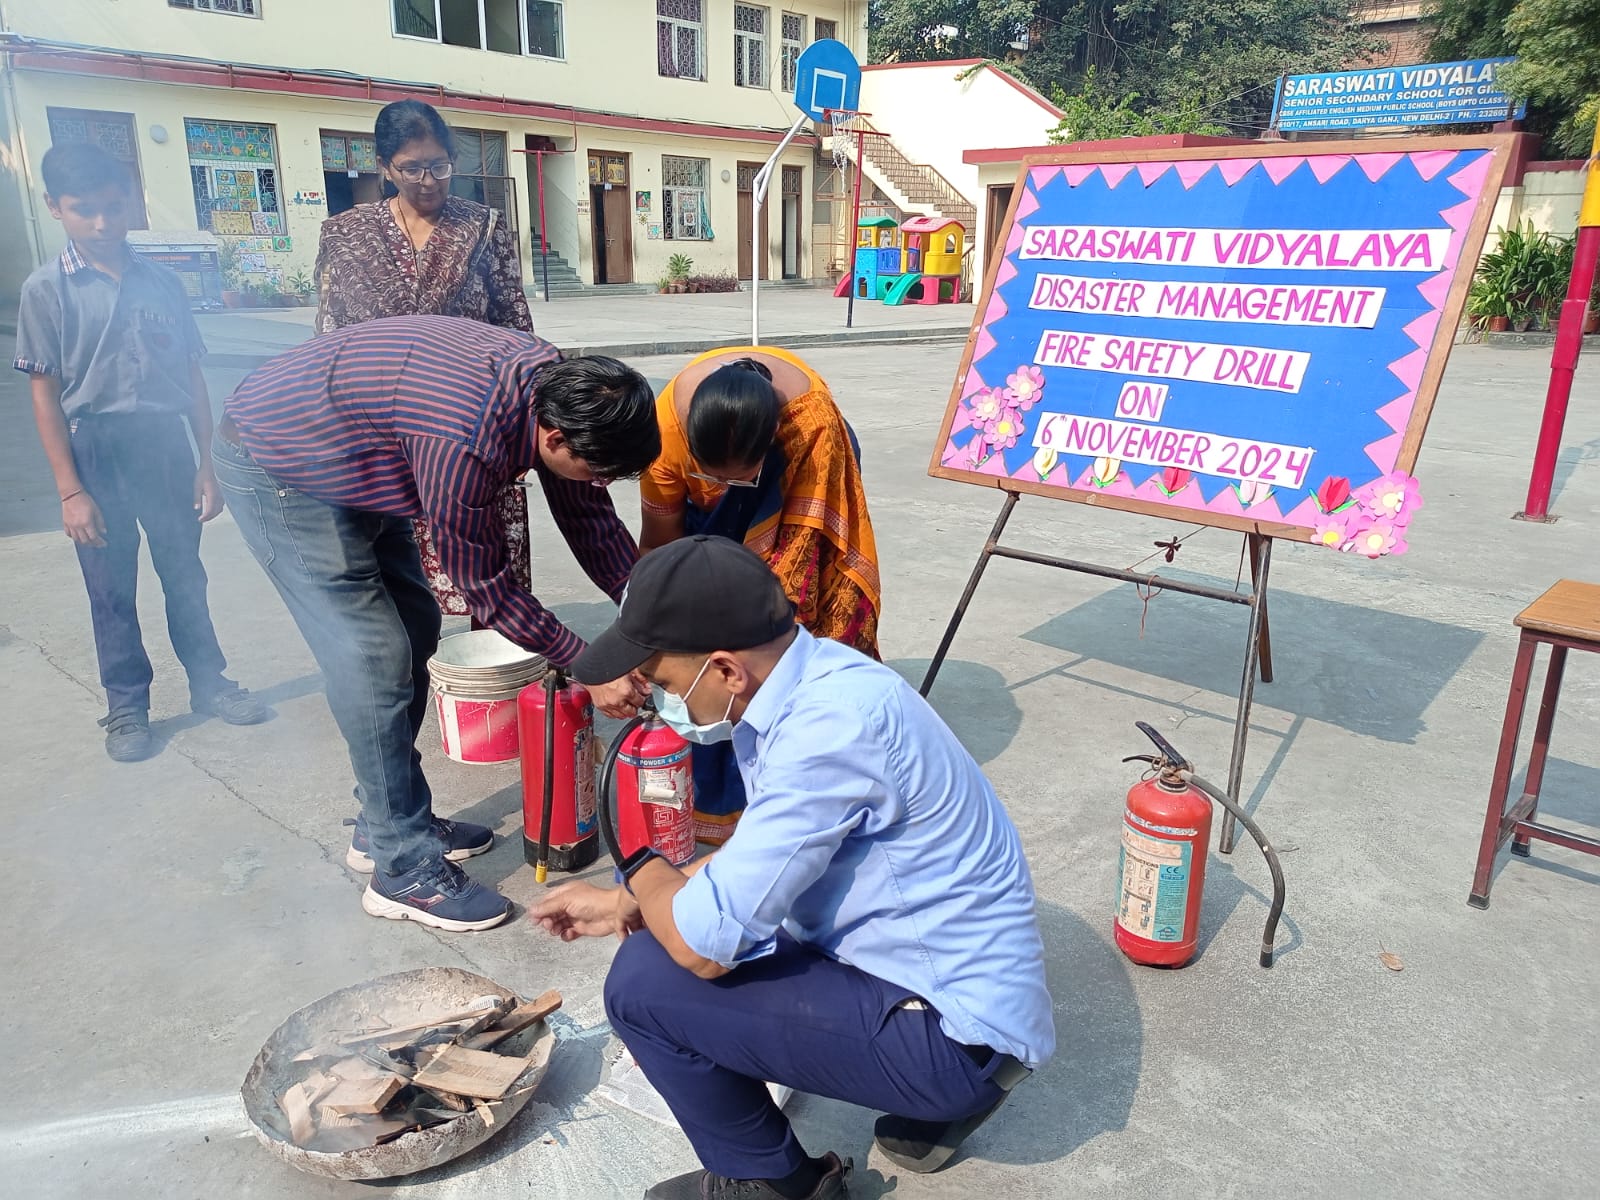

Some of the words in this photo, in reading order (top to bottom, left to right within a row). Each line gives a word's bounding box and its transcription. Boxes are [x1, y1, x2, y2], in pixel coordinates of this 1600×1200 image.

[1284, 72, 1395, 97] SARASWATI
[1401, 62, 1510, 89] VIDYALA
[1284, 97, 1323, 108] SENIOR
[1325, 92, 1393, 106] SECONDARY
[1395, 89, 1444, 100] SCHOOL
[1447, 86, 1473, 97] FOR
[1295, 108, 1328, 117] AFFILIATED
[1329, 106, 1356, 115] ENGLISH
[1356, 104, 1382, 113] MEDIUM
[1382, 103, 1407, 112] PUBLIC
[1407, 101, 1434, 110] SCHOOL
[1457, 98, 1477, 107] UPTO
[1478, 97, 1502, 105] CLASS
[1302, 119, 1329, 128] ANSARI
[1329, 117, 1351, 127] ROAD,
[1352, 116, 1376, 125] DARYA
[1377, 115, 1399, 125] GANJ,
[1401, 113, 1419, 122] NEW
[1025, 229, 1196, 262] SARASWATI
[1213, 232, 1432, 268] VIDYALAYA
[1033, 276, 1145, 313] DISASTER
[1156, 283, 1375, 325] MANAGEMENT
[1039, 333, 1093, 367] FIRE
[1100, 338, 1206, 377] SAFETY
[1213, 347, 1295, 391] DRILL
[1118, 385, 1165, 418] ON
[1065, 417, 1212, 469] NOVEMBER
[1215, 441, 1311, 483] 2024
[639, 758, 666, 767] POWDER
[1166, 866, 1180, 874] CE
